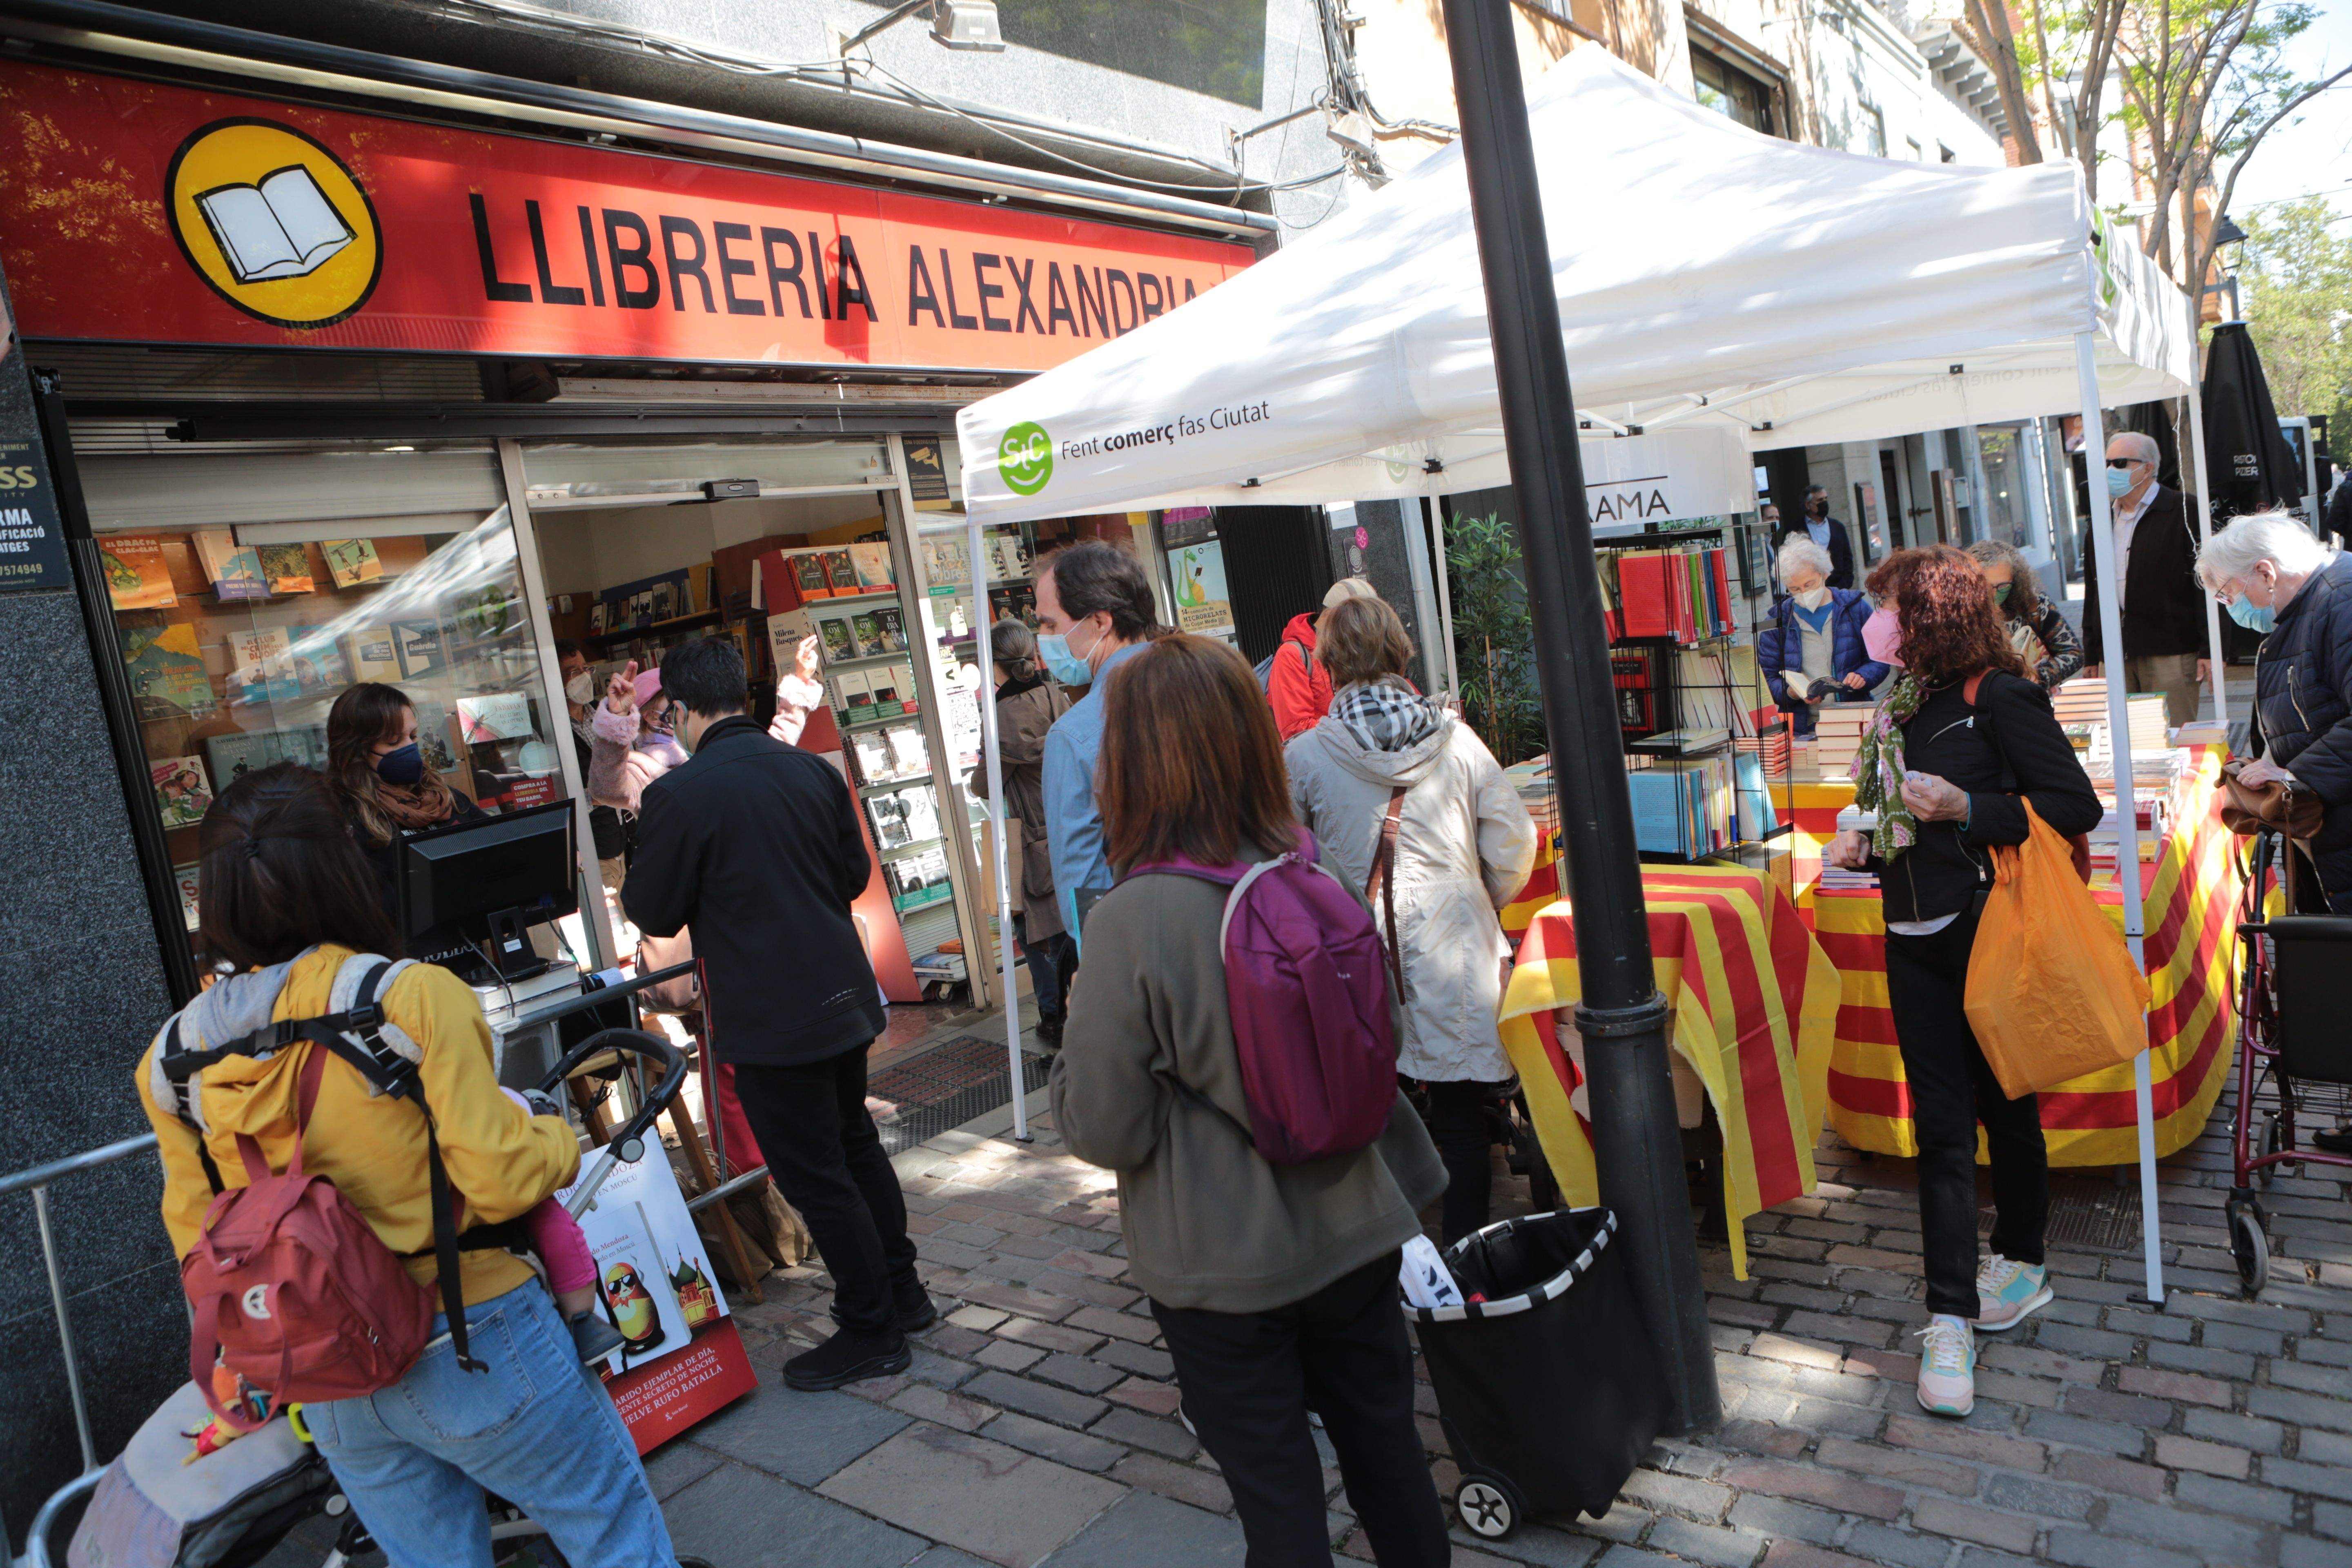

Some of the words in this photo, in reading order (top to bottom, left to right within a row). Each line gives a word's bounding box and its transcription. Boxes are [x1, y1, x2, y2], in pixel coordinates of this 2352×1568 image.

[469, 193, 879, 322] LLIBRERIA
[1062, 437, 1100, 460] Fent
[1104, 424, 1174, 451] comerç
[1178, 416, 1205, 437] fas
[1210, 401, 1270, 430] Ciutat
[1590, 489, 1671, 523] AMA
[116, 539, 145, 547] DRAC
[116, 546, 159, 554] CLAC-CLAC
[1183, 609, 1227, 623] MICRORELATS
[828, 626, 840, 634] OM
[886, 621, 899, 630] ERA
[774, 628, 795, 637] Milena
[254, 635, 276, 645] CLUB
[776, 634, 804, 646] Busquets
[249, 644, 271, 653] CRIM
[409, 642, 436, 651] Guàrdia
[216, 736, 236, 744] XAVIER
[514, 782, 536, 791] COMPRA
[514, 788, 539, 797] LLIBRERIA
[597, 1187, 609, 1197] EN
[610, 1172, 638, 1192] MOSCÚ
[600, 1233, 629, 1250] Mendoza
[616, 1240, 635, 1254] Moscú
[615, 1386, 642, 1407] ARIDO
[643, 1363, 685, 1390] EJEMPLAR
[685, 1356, 697, 1367] DE
[697, 1347, 715, 1360] DÍA,
[642, 1378, 676, 1401] SECRETO
[677, 1371, 688, 1382] DE
[688, 1355, 718, 1375] NOCHE.
[653, 1388, 680, 1410] RUFO
[681, 1363, 724, 1393] BATALLA
